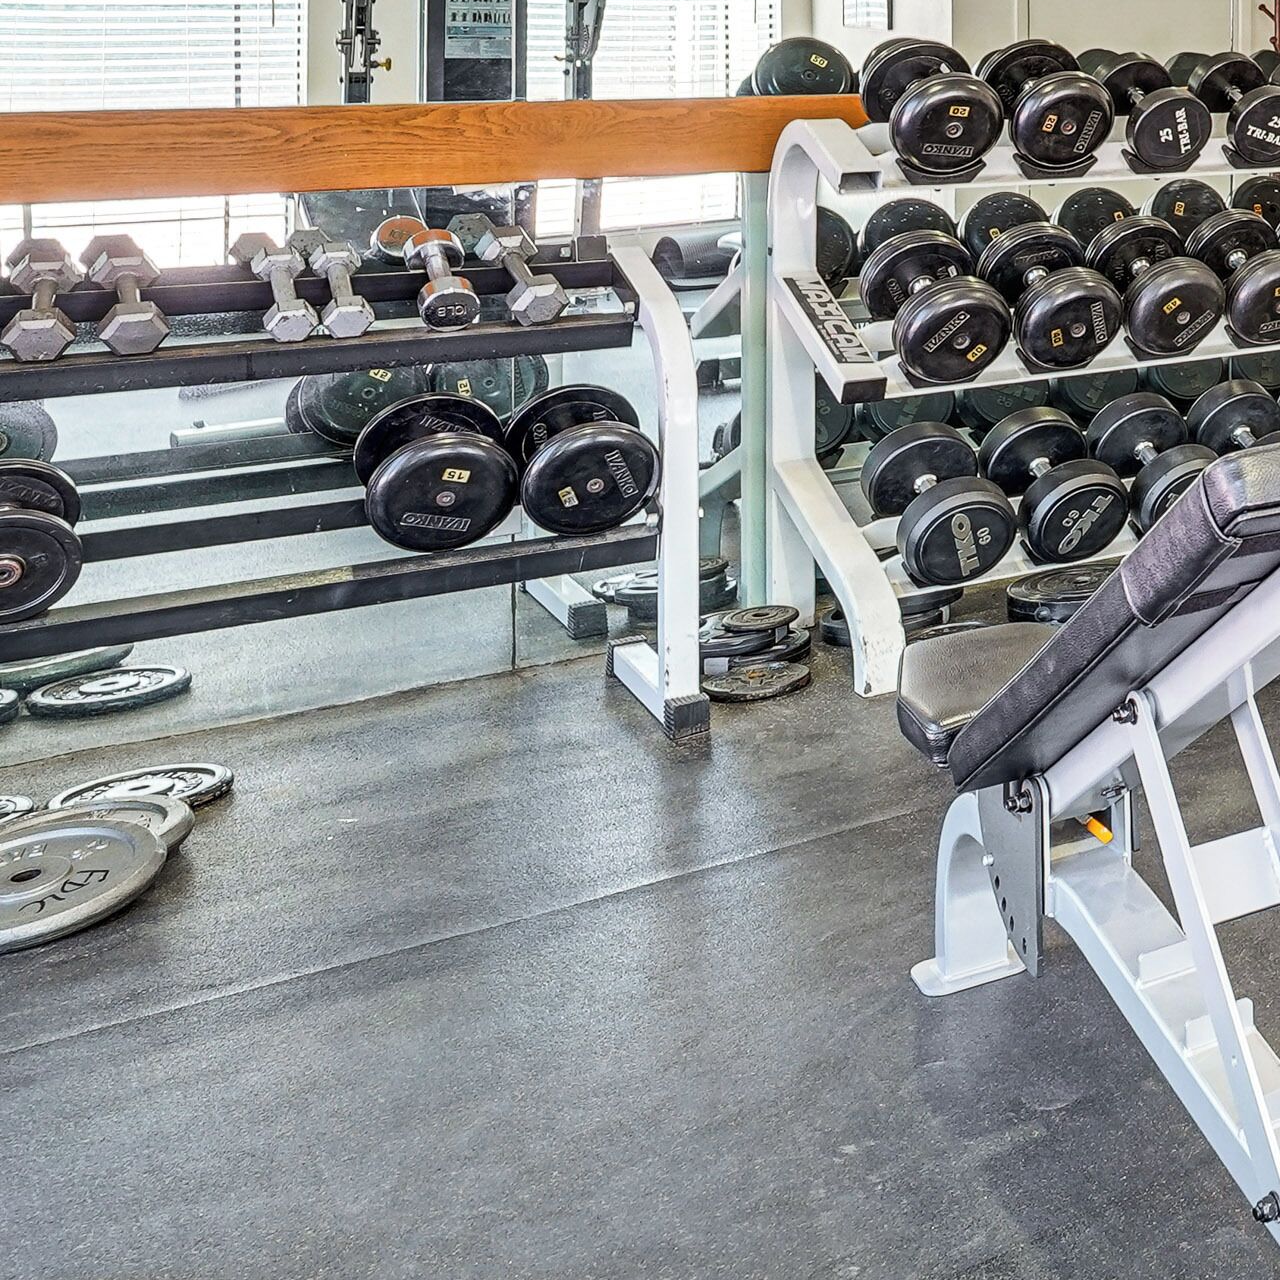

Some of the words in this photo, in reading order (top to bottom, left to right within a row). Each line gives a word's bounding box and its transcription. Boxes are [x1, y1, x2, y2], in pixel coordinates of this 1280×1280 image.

[950, 107, 969, 117] 20
[1042, 115, 1057, 132] 20
[1074, 111, 1102, 152] IVANKO
[1160, 128, 1173, 142] 25
[922, 144, 973, 157] IVANKO
[924, 311, 970, 352] IVANKO
[1091, 301, 1108, 344] IVANKO
[967, 343, 988, 361] 40
[442, 469, 470, 483] 15
[604, 449, 639, 498] IVANKO
[400, 512, 471, 531] IVANKO
[1058, 494, 1114, 555] TKO
[1062, 510, 1079, 527] 60
[951, 513, 979, 577] TKO
[977, 527, 991, 545] 60
